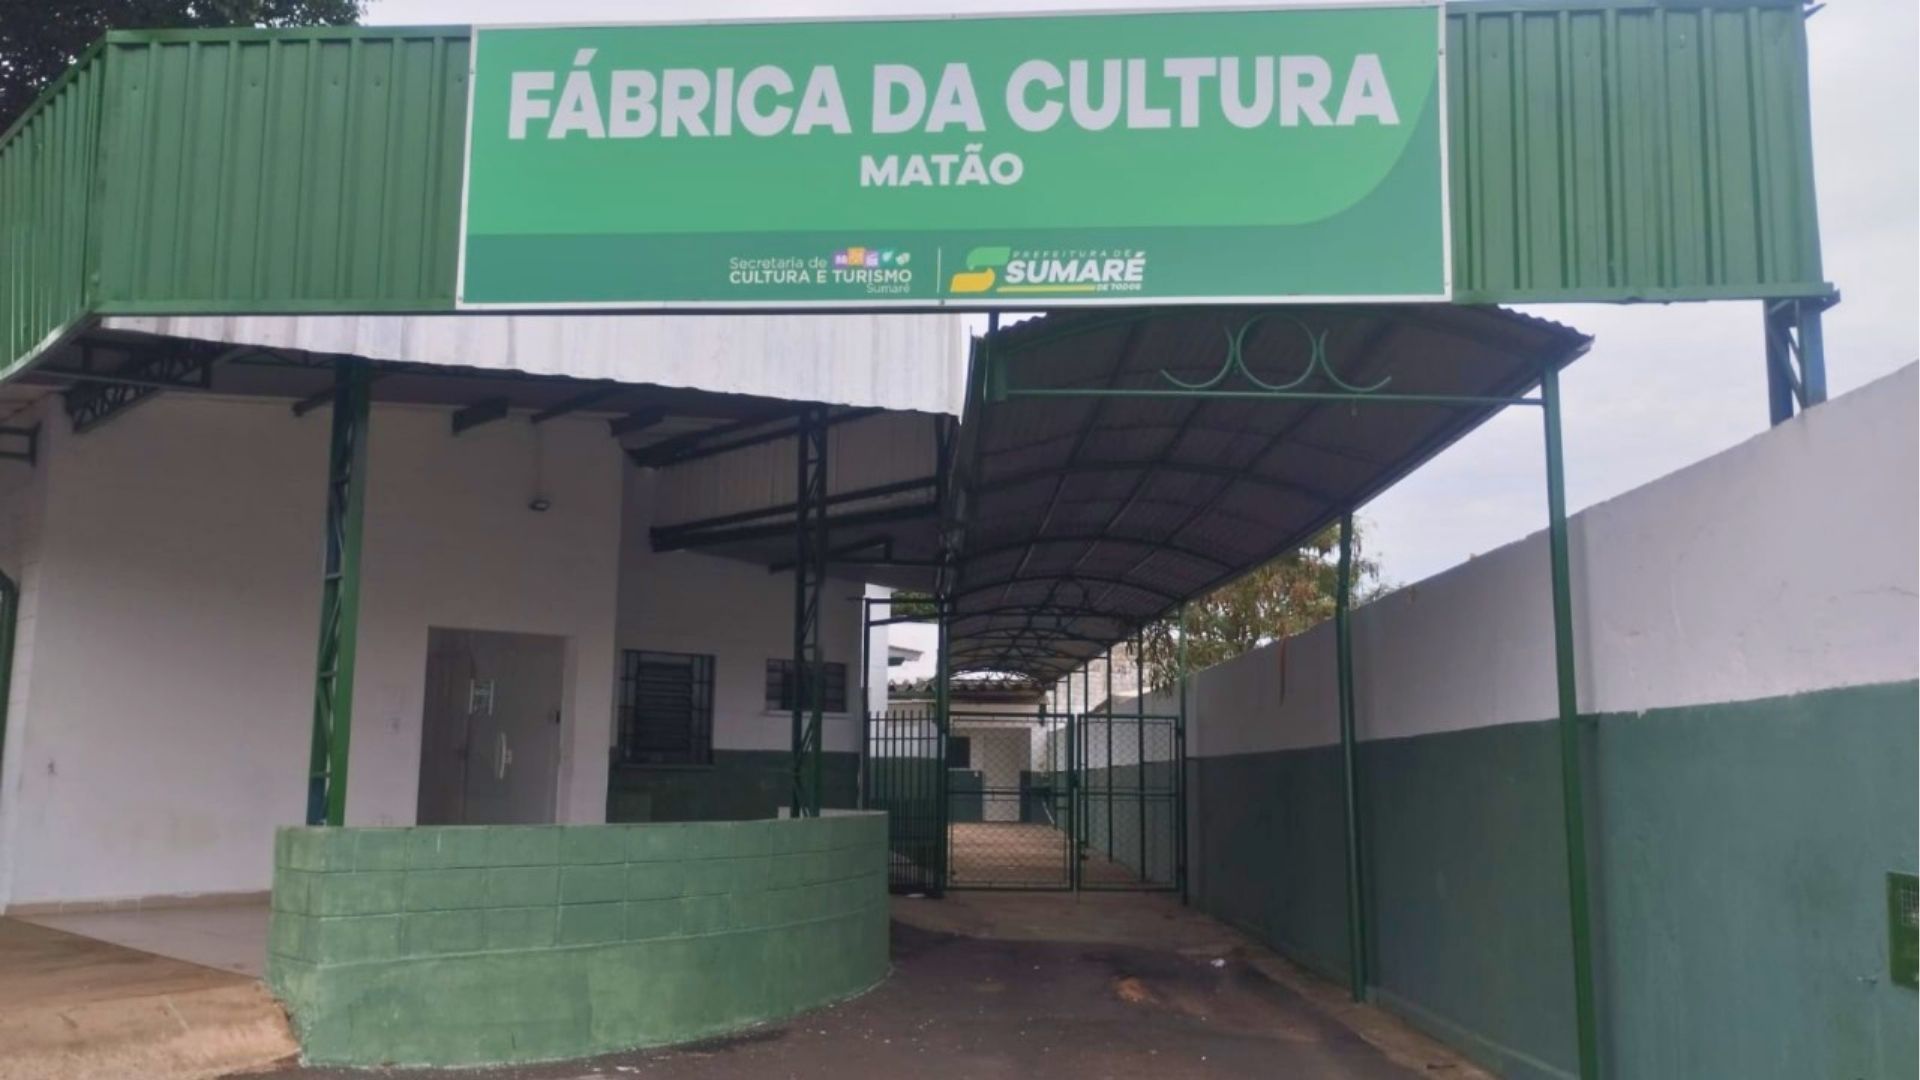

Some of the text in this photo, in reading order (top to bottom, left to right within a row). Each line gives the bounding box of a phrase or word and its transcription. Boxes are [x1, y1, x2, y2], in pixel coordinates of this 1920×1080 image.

[508, 48, 1401, 140] FÁBRICA DA CULTURA
[860, 143, 1024, 187] MATÃO
[1012, 249, 1132, 259] PREFEITURA DE
[729, 255, 827, 270] Secretaria de
[1004, 251, 1146, 284] SUMARÉ
[729, 269, 912, 284] CULTURA E TURISMO
[866, 282, 911, 294] Sumaré
[1096, 283, 1109, 291] DE
